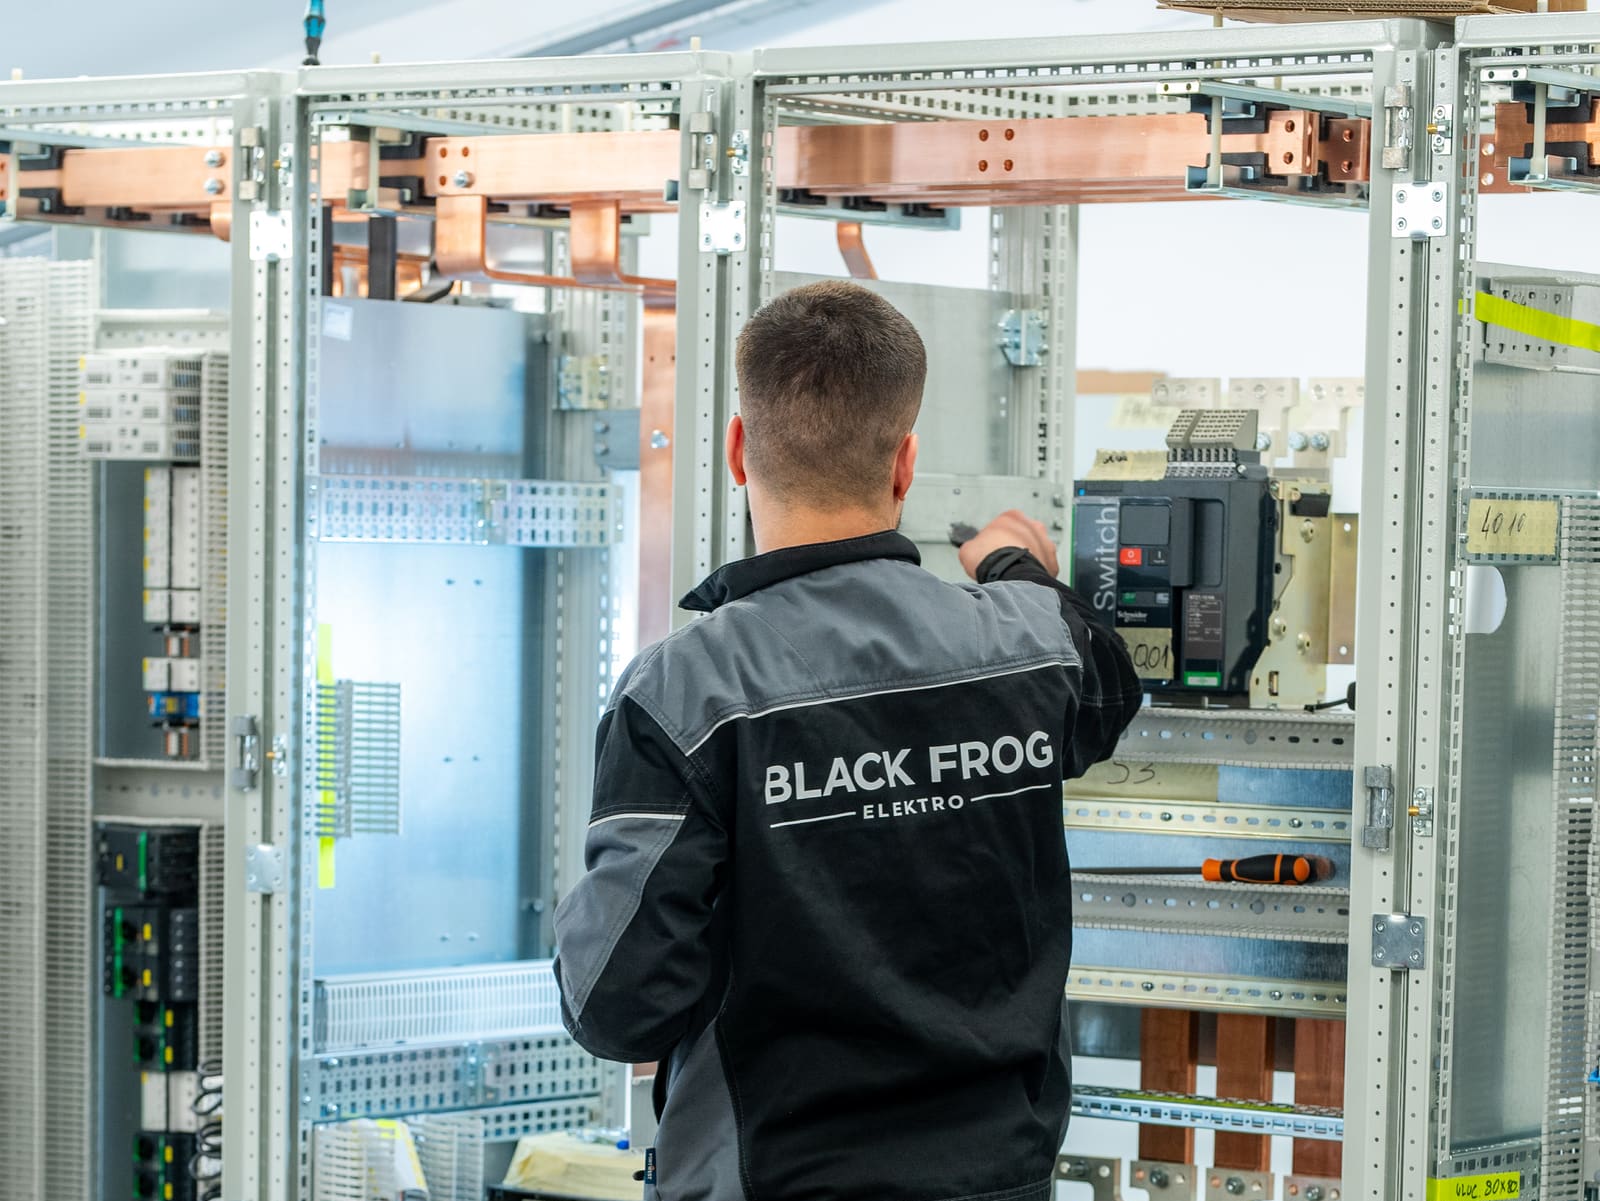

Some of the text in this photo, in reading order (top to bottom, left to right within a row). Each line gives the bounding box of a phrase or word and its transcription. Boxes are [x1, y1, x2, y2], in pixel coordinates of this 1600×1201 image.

[1092, 506, 1118, 611] Switch
[764, 730, 1054, 805] BLACK FROG
[863, 794, 965, 819] ELEKTRO
